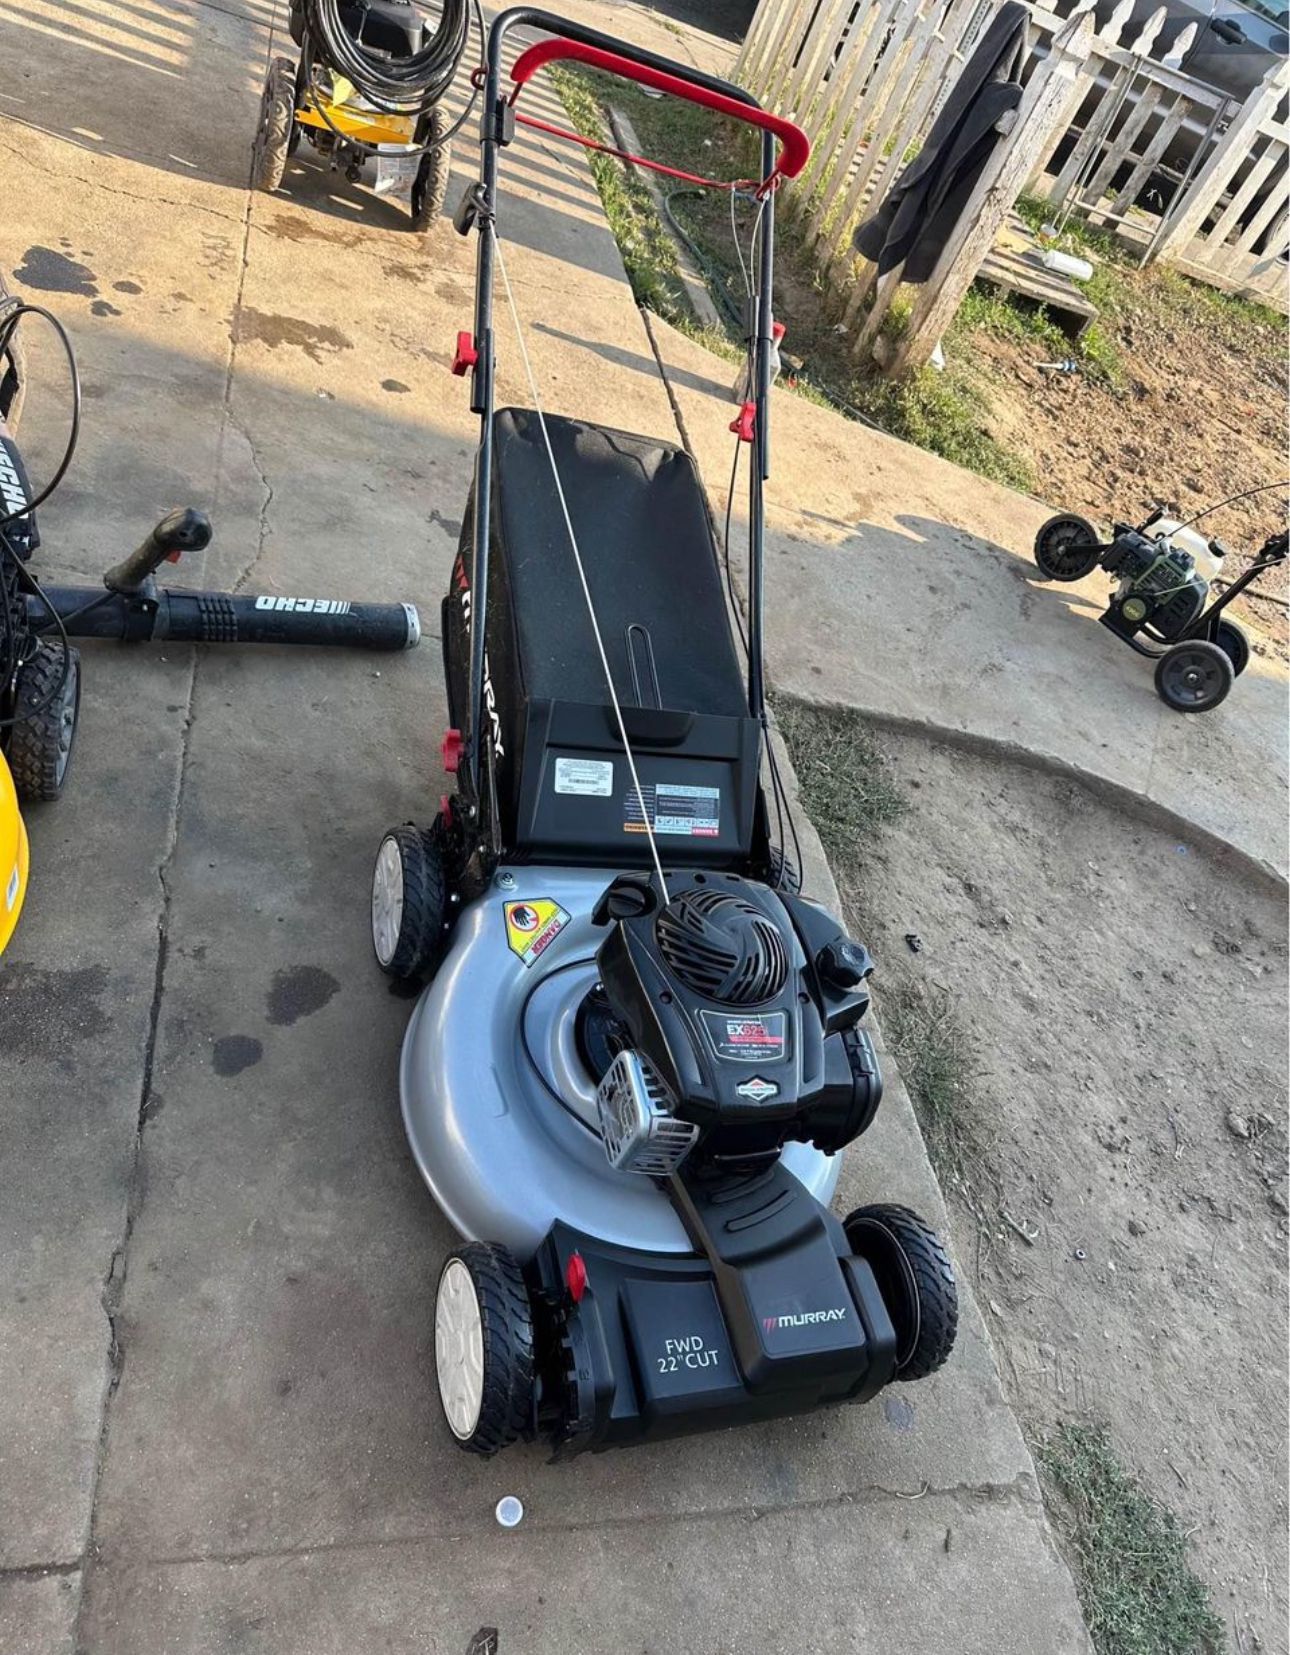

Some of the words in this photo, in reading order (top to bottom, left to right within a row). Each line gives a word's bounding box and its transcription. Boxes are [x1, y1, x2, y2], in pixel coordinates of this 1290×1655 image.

[255, 595, 330, 613] ECHO
[531, 919, 561, 954] DANGER
[779, 1308, 846, 1329] MURRAY
[665, 1335, 704, 1355] FWD
